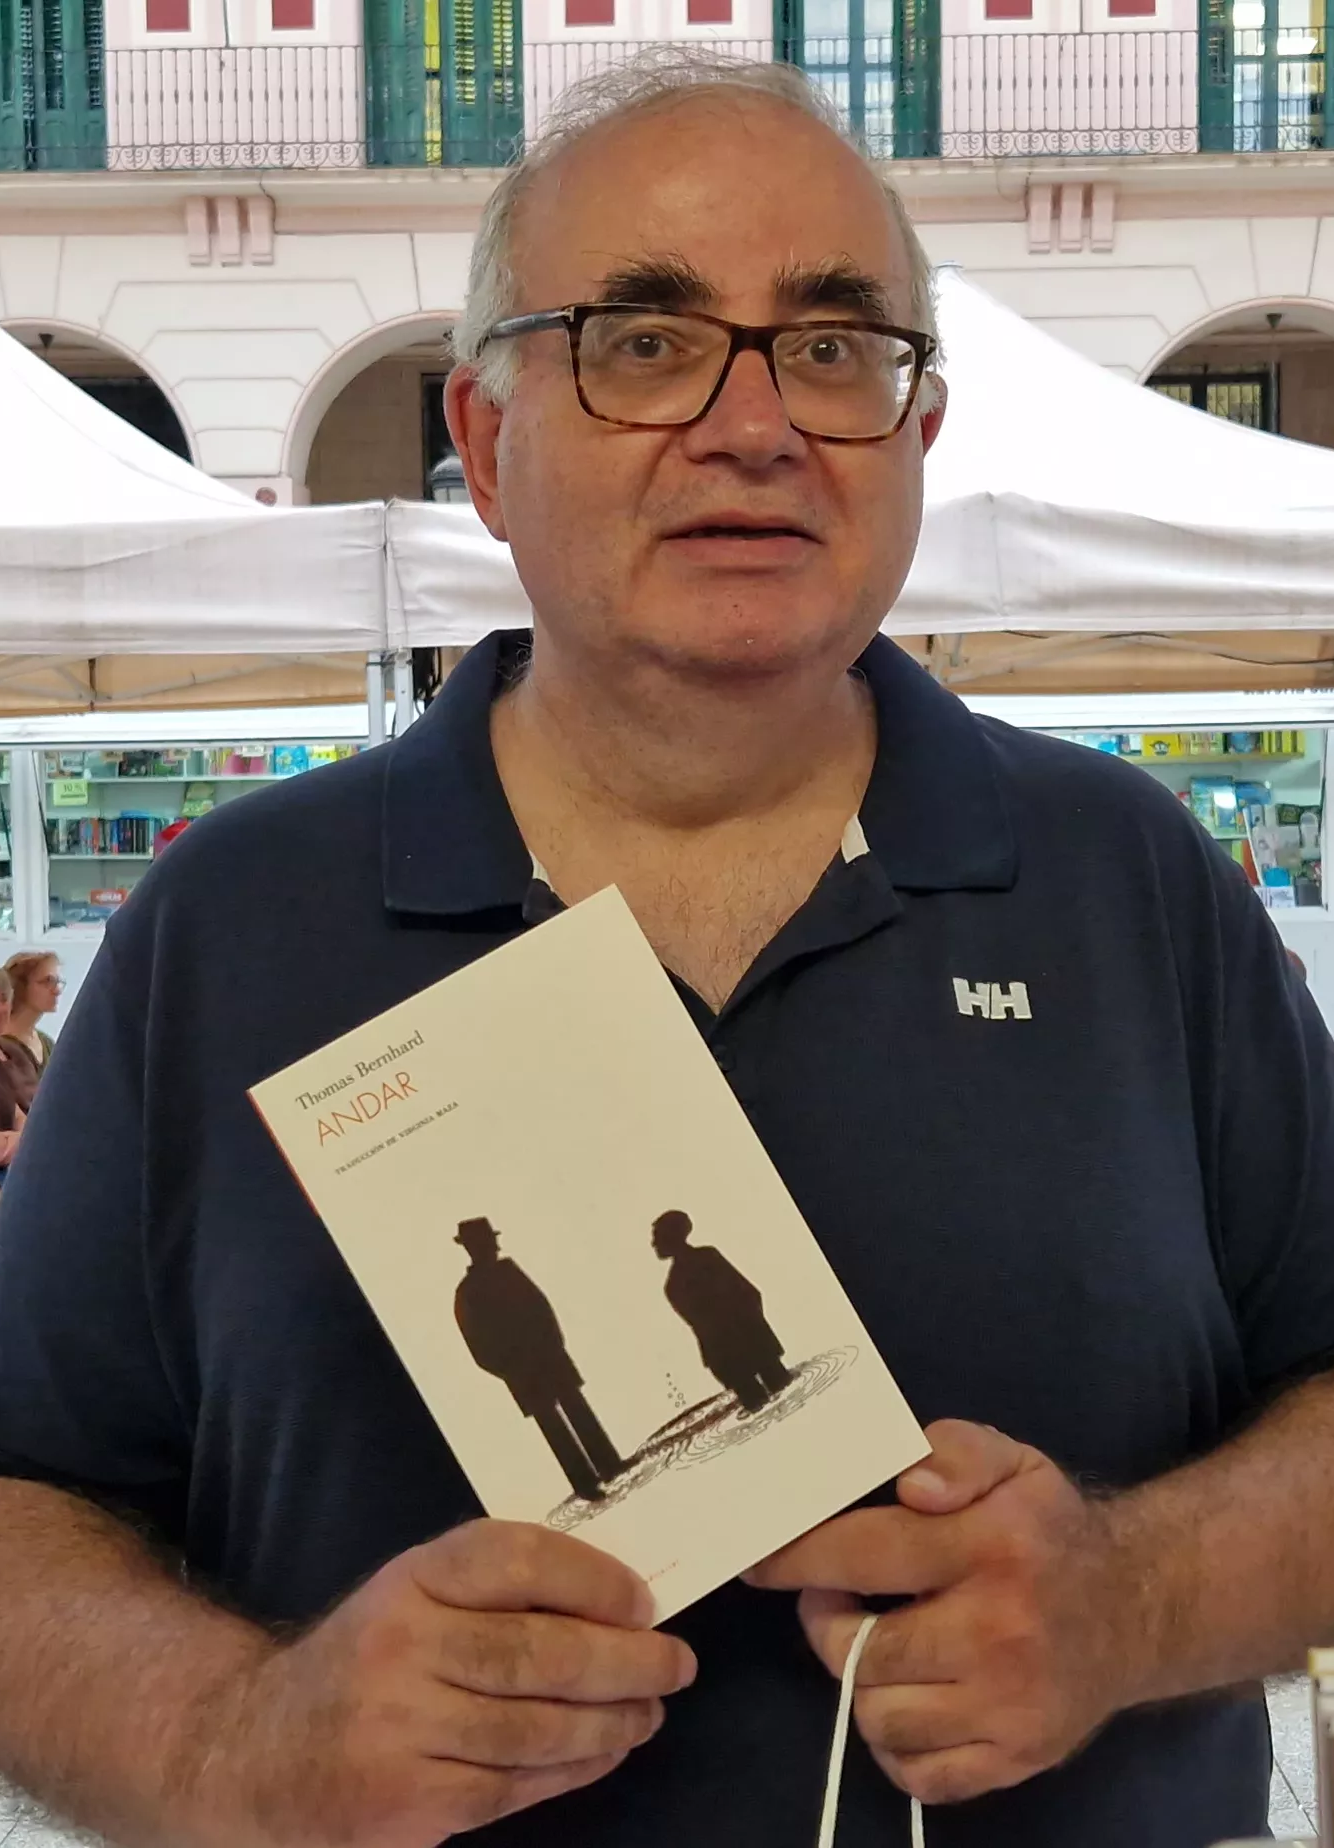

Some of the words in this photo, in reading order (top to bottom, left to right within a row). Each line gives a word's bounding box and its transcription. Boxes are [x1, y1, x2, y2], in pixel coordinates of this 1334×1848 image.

[953, 977, 1032, 1019] HH
[295, 1073, 355, 1110] Thomas
[354, 1029, 424, 1078] Bernhard
[317, 1071, 418, 1147] ANDAR
[335, 1142, 385, 1175] TRADUCCIÓN
[386, 1135, 397, 1147] DE
[398, 1115, 435, 1138] VIRGINIA
